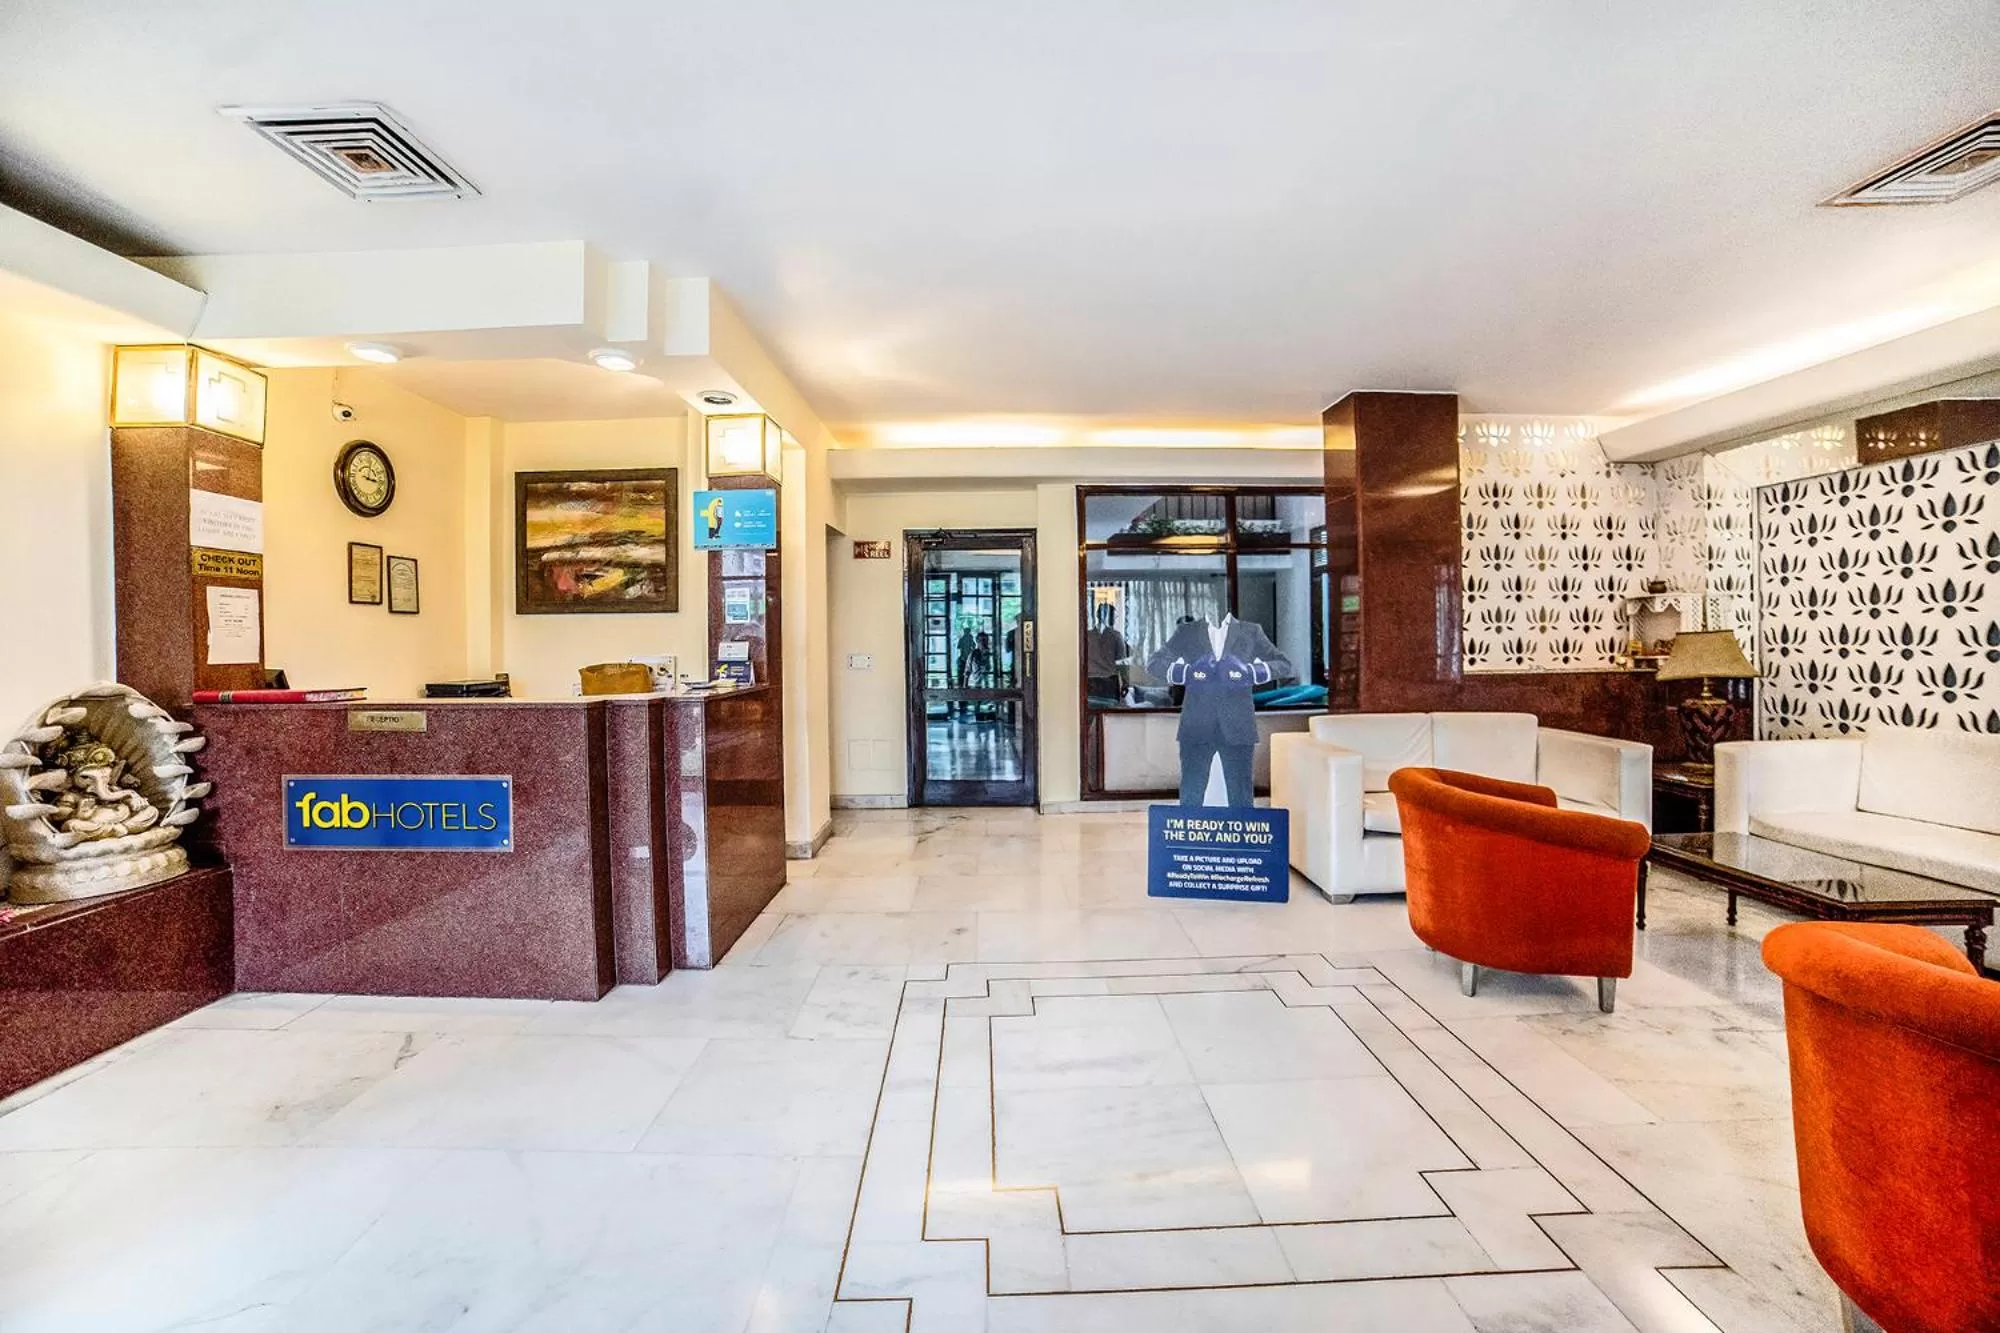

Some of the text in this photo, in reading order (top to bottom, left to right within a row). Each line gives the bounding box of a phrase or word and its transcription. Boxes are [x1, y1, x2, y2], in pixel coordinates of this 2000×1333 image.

[200, 553, 257, 566] CHECK OUT
[197, 563, 221, 572] Time
[236, 567, 260, 576] Noon
[295, 792, 498, 831] fabHOTELS
[1166, 819, 1270, 833] I'M READY TO WIN
[1163, 830, 1273, 845] THE DAY. AND YOU?
[1173, 854, 1189, 862] TAKE
[1195, 856, 1220, 864] PICTURE
[1193, 864, 1214, 872] SOCIAL
[1215, 865, 1236, 873] MEDIA
[1184, 881, 1211, 889] COLLECT
[1217, 883, 1249, 891] SURPRISE
